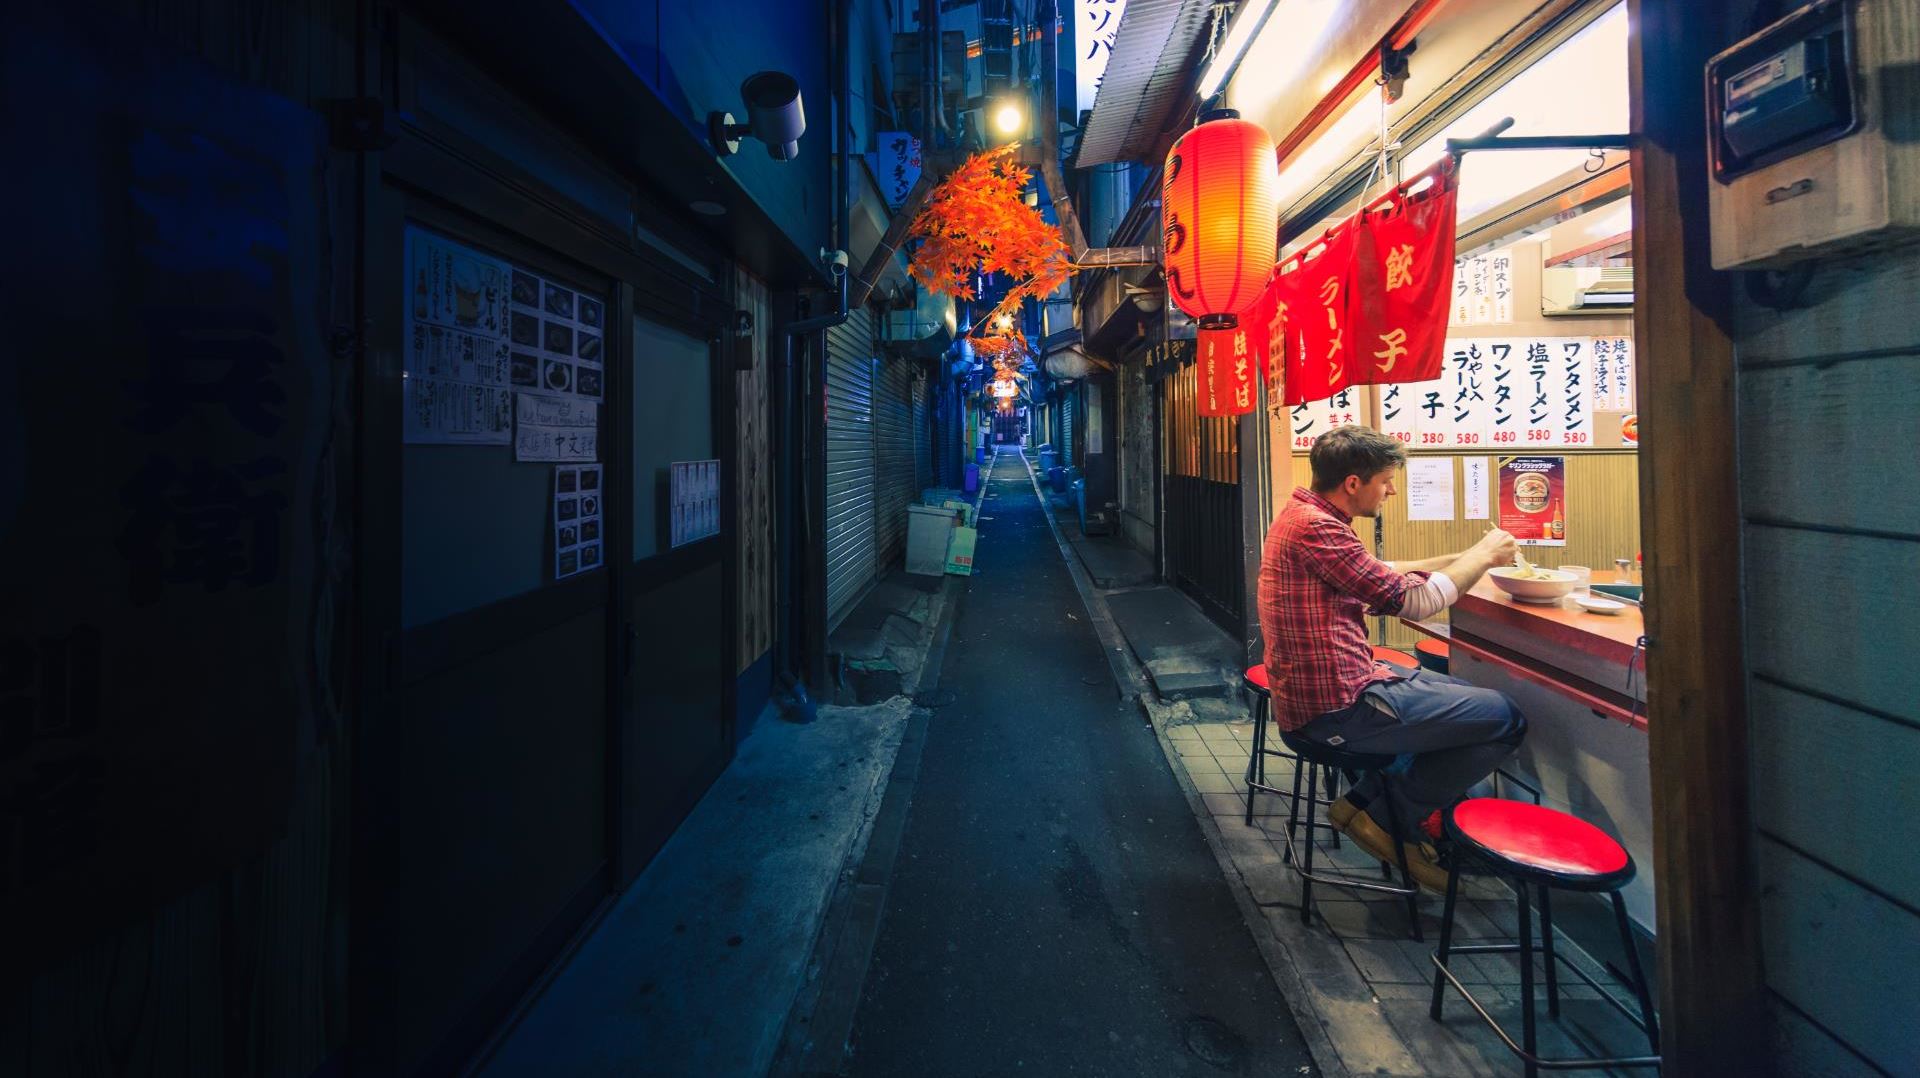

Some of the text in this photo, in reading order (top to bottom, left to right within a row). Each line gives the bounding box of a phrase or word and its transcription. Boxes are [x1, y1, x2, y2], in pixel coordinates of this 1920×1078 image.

[1087, 0, 1115, 60] ソバ
[1494, 257, 1511, 299] 卵スープ
[1319, 276, 1343, 386] ラーメン
[1234, 331, 1249, 407] 焼そば
[1453, 351, 1470, 423] ラーメン
[1467, 343, 1484, 401] もやし入
[1491, 344, 1511, 425] ワンタン
[1527, 342, 1550, 424] 塩ラーメン
[1564, 342, 1583, 430] ワンタンメン
[1422, 433, 1444, 443] 380
[1457, 433, 1479, 444] 580
[1493, 431, 1516, 442] 480
[1528, 429, 1550, 440] 580
[1564, 432, 1587, 443] 580
